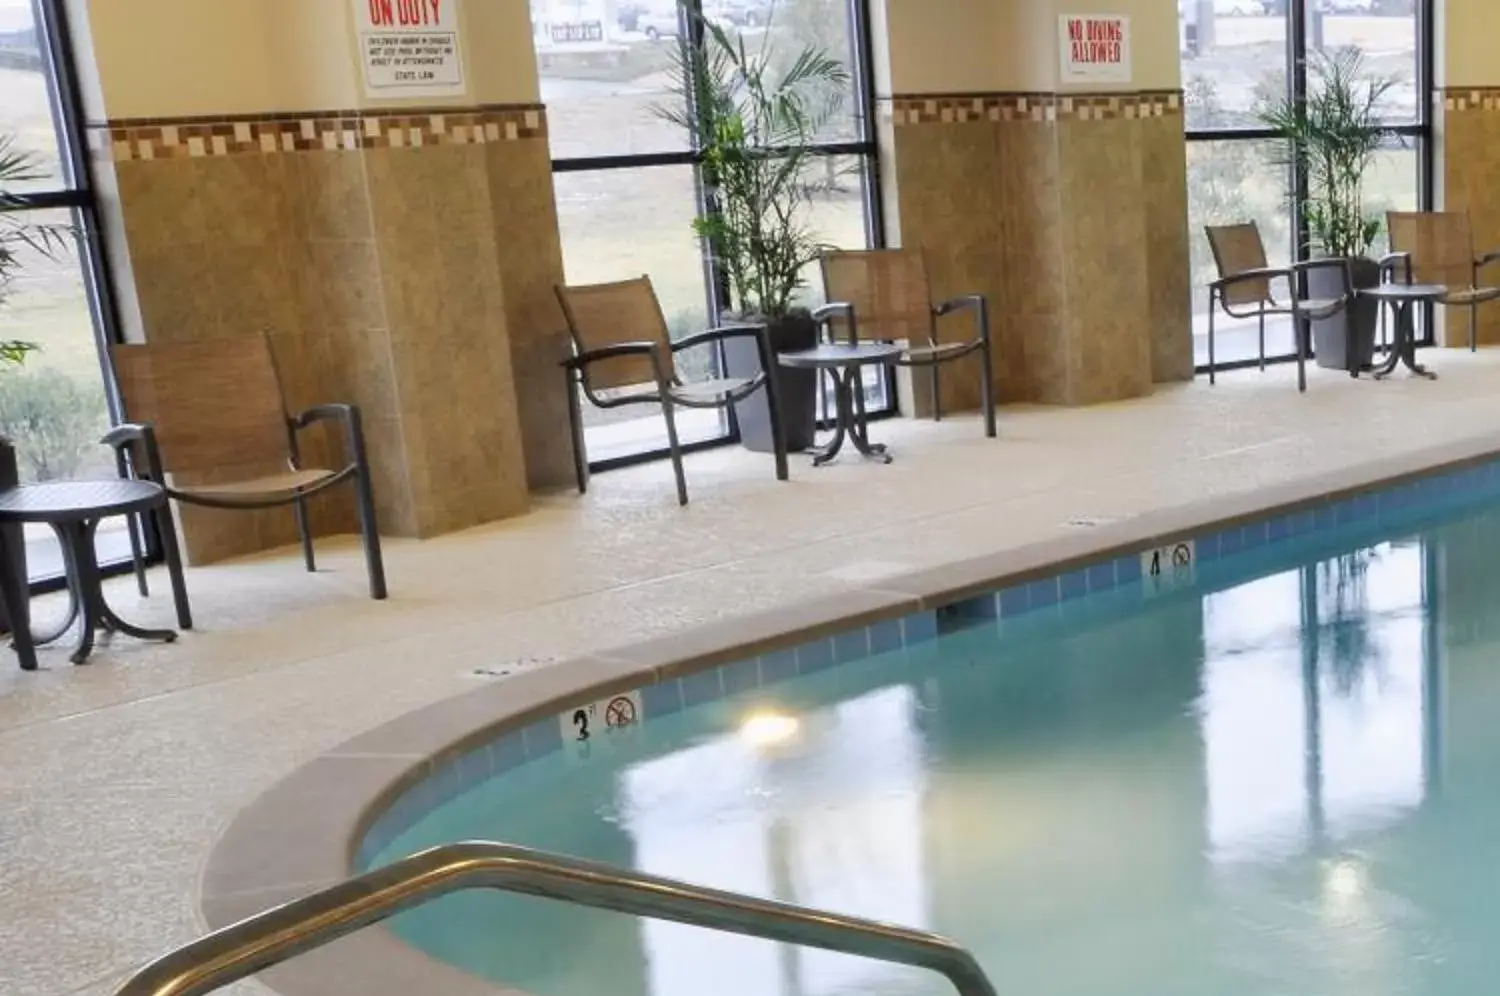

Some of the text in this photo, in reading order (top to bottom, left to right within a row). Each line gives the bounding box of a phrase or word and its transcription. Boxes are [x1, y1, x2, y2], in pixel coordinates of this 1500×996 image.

[368, 0, 441, 26] ON DUTY
[1067, 19, 1122, 41] NO DIVING
[1071, 41, 1121, 63] ALLOWED
[394, 71, 416, 81] STATE
